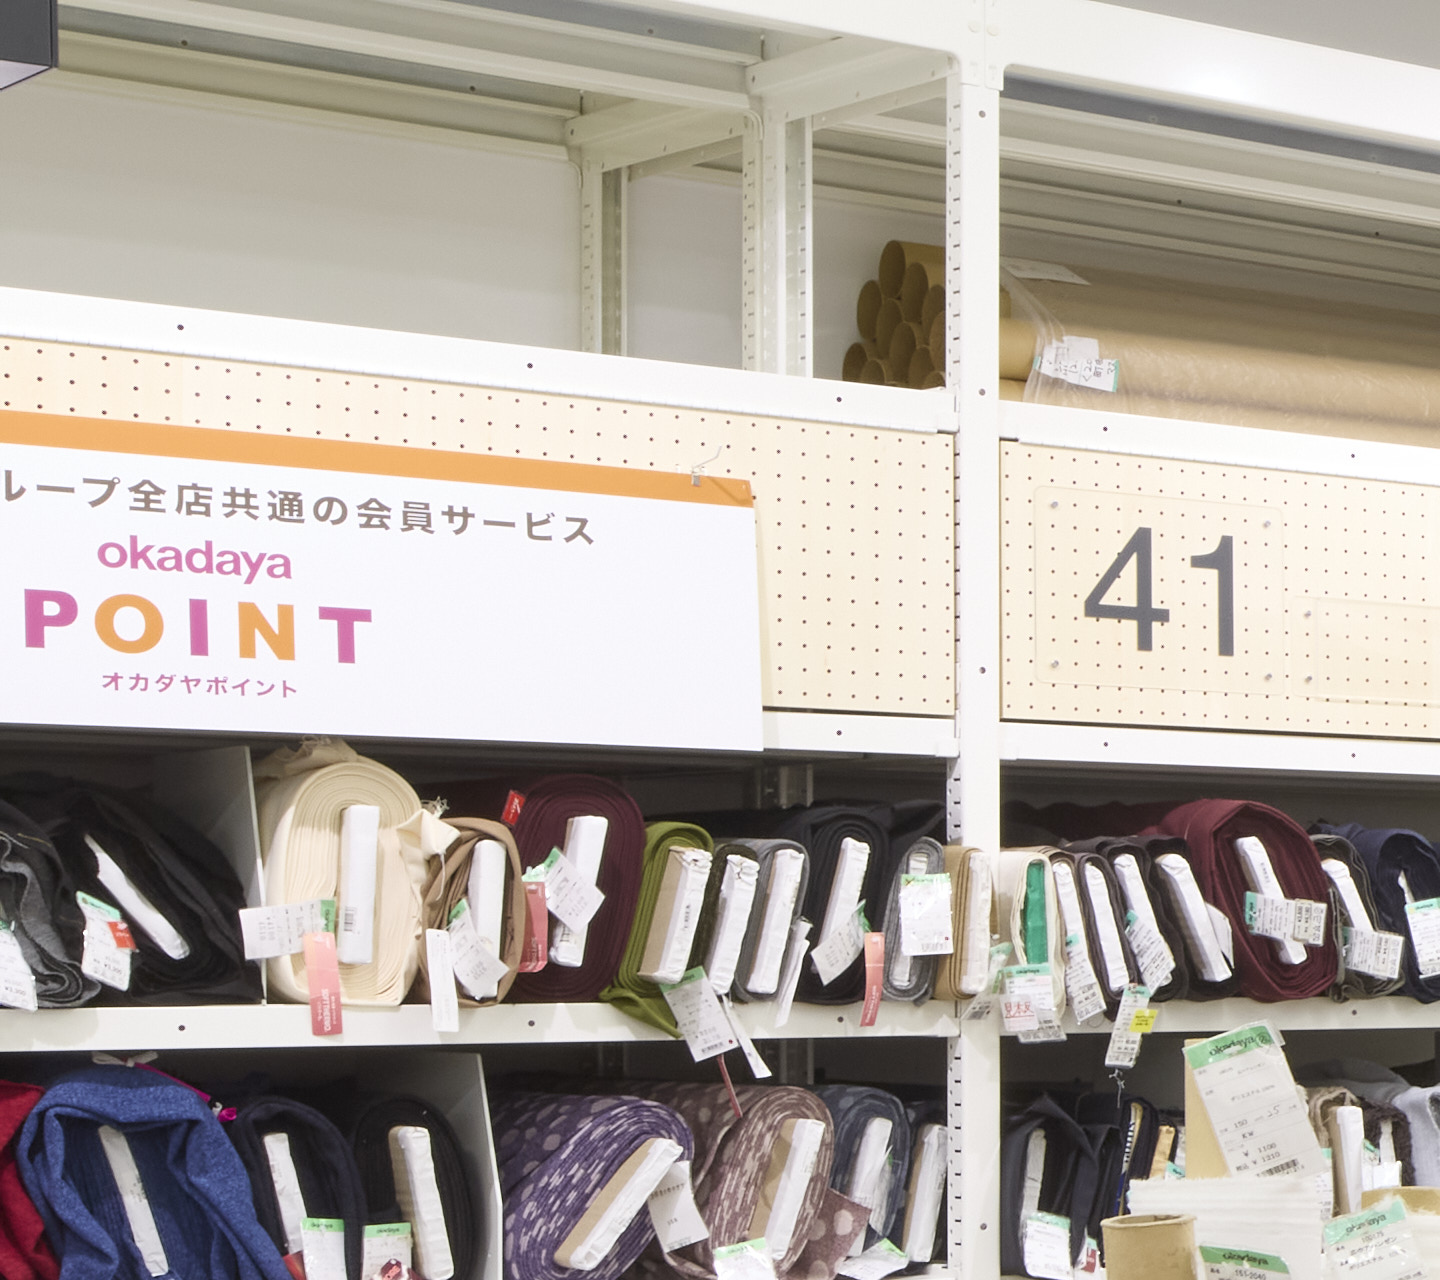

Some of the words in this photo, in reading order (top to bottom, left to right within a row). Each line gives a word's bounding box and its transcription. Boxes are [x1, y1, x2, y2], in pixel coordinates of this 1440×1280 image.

[97, 535, 293, 584] okadaya
[1083, 526, 1237, 656] 41
[24, 588, 372, 664] POINT
[101, 671, 298, 699] オカダヤポイント
